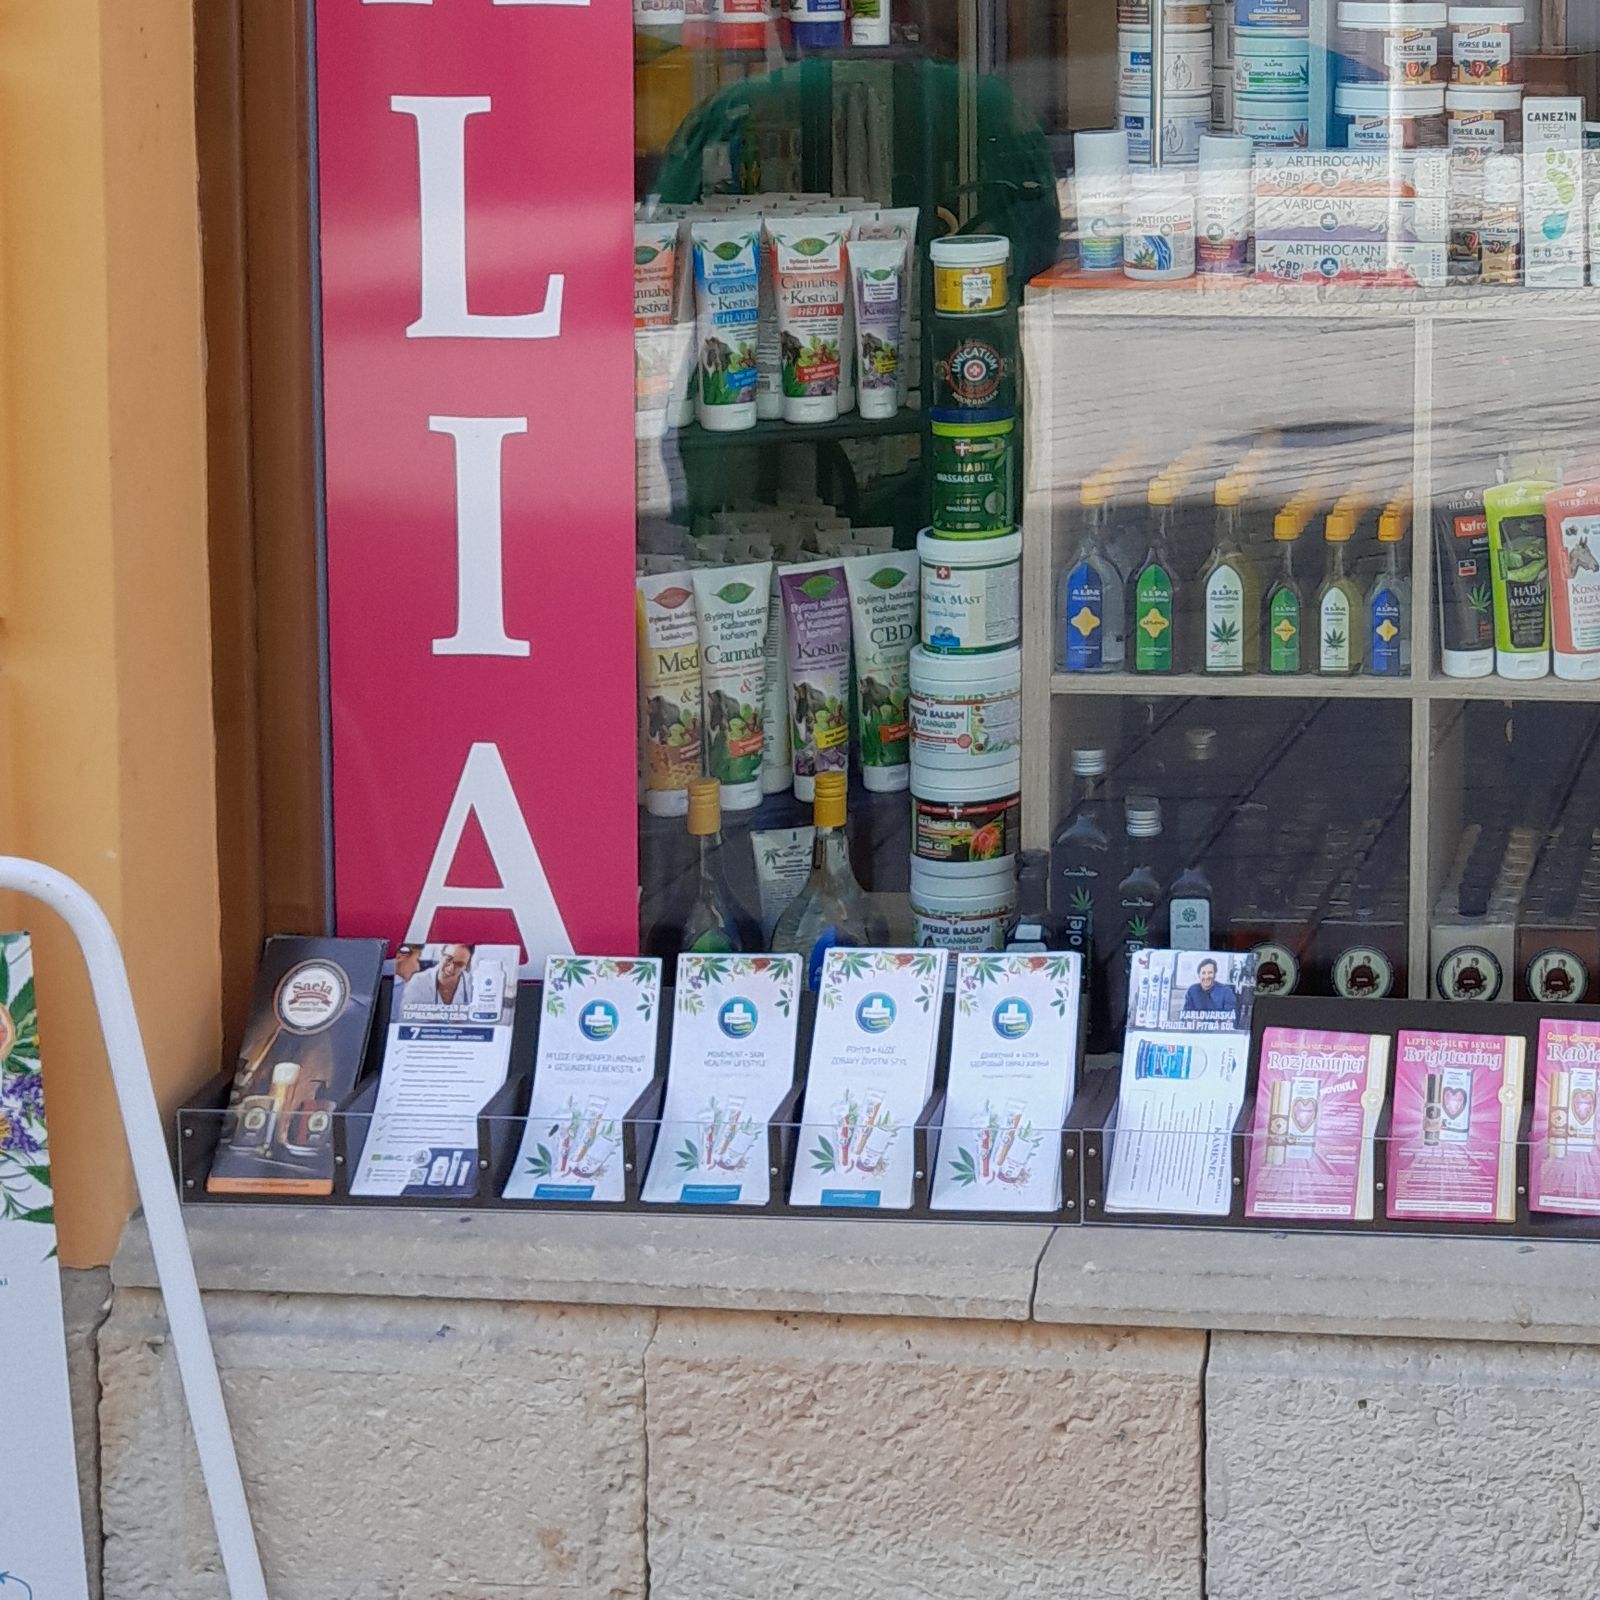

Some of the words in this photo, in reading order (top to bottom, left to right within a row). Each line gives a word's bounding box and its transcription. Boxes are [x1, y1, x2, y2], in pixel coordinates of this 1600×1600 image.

[1286, 154, 1381, 168] ARTHROCANN
[1286, 244, 1381, 257] ARTHROCANN
[781, 274, 839, 290] Cannabis
[789, 291, 839, 305] Kostival
[951, 346, 998, 373] UNICATUM
[1211, 589, 1239, 597] ALPA
[870, 624, 913, 646] CBD
[658, 648, 700, 674] Med
[929, 708, 965, 720] BALSAM
[952, 924, 990, 935] BALSAM
[1069, 914, 1087, 948] olej
[1179, 1009, 1236, 1020] KARLOVARSKÁ
